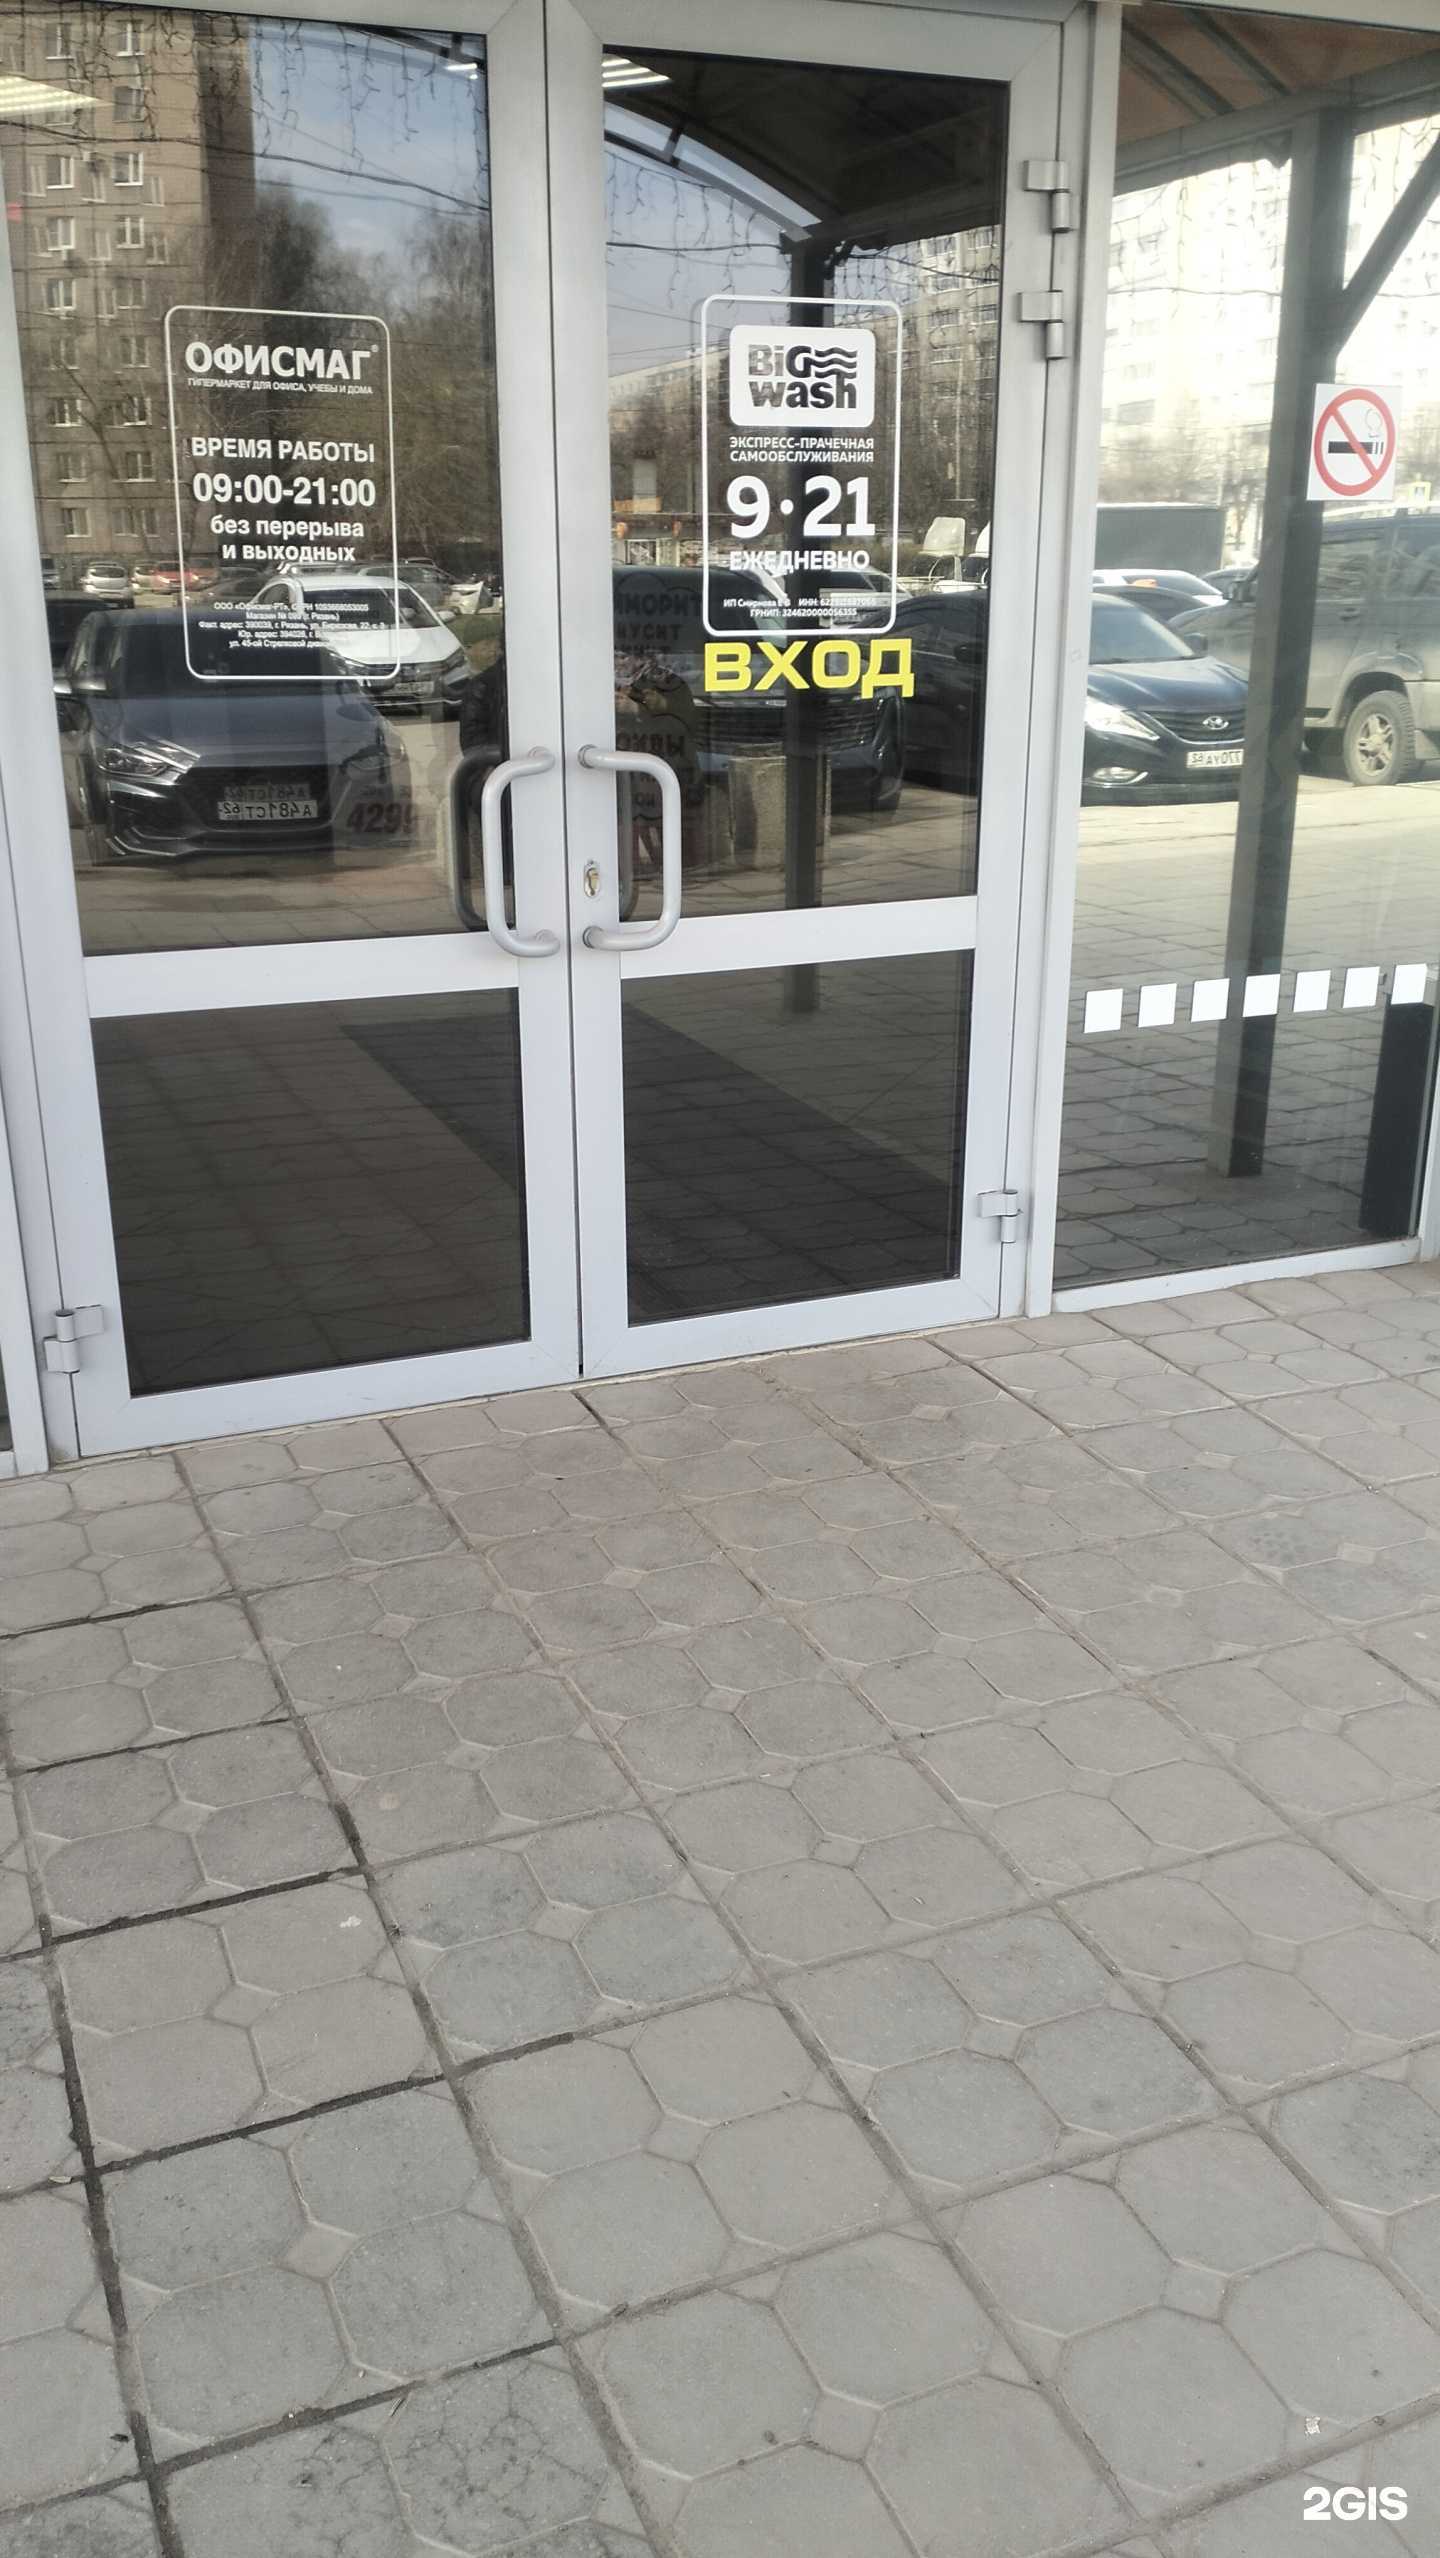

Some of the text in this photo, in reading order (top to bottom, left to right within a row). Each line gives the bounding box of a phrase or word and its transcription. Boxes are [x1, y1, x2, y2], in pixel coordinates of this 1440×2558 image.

[185, 341, 371, 380] ОФИСМАГ
[187, 378, 373, 395] ГИПЕРМАРКЕТ ДЛЯ ОФИСА, УЧЕБЫ И ДОМА
[748, 372, 857, 409] wash
[191, 437, 375, 463] ВРЕМЯ РАБОТЫ
[729, 436, 874, 450] ЭКСПРЕСС-ПРАЧЕЧНАЯ
[730, 450, 874, 463] САМООБСЛУЖИВАНИЯ
[193, 472, 376, 507] 09:00-21:00
[210, 514, 364, 541] без перерыва
[242, 545, 356, 564] выходных
[729, 550, 870, 575] ЕЖЕДНЕВНО
[213, 602, 233, 610] ООО
[723, 598, 737, 608] ИП
[798, 598, 819, 608] ИНН:
[704, 638, 915, 699] ВХОД
